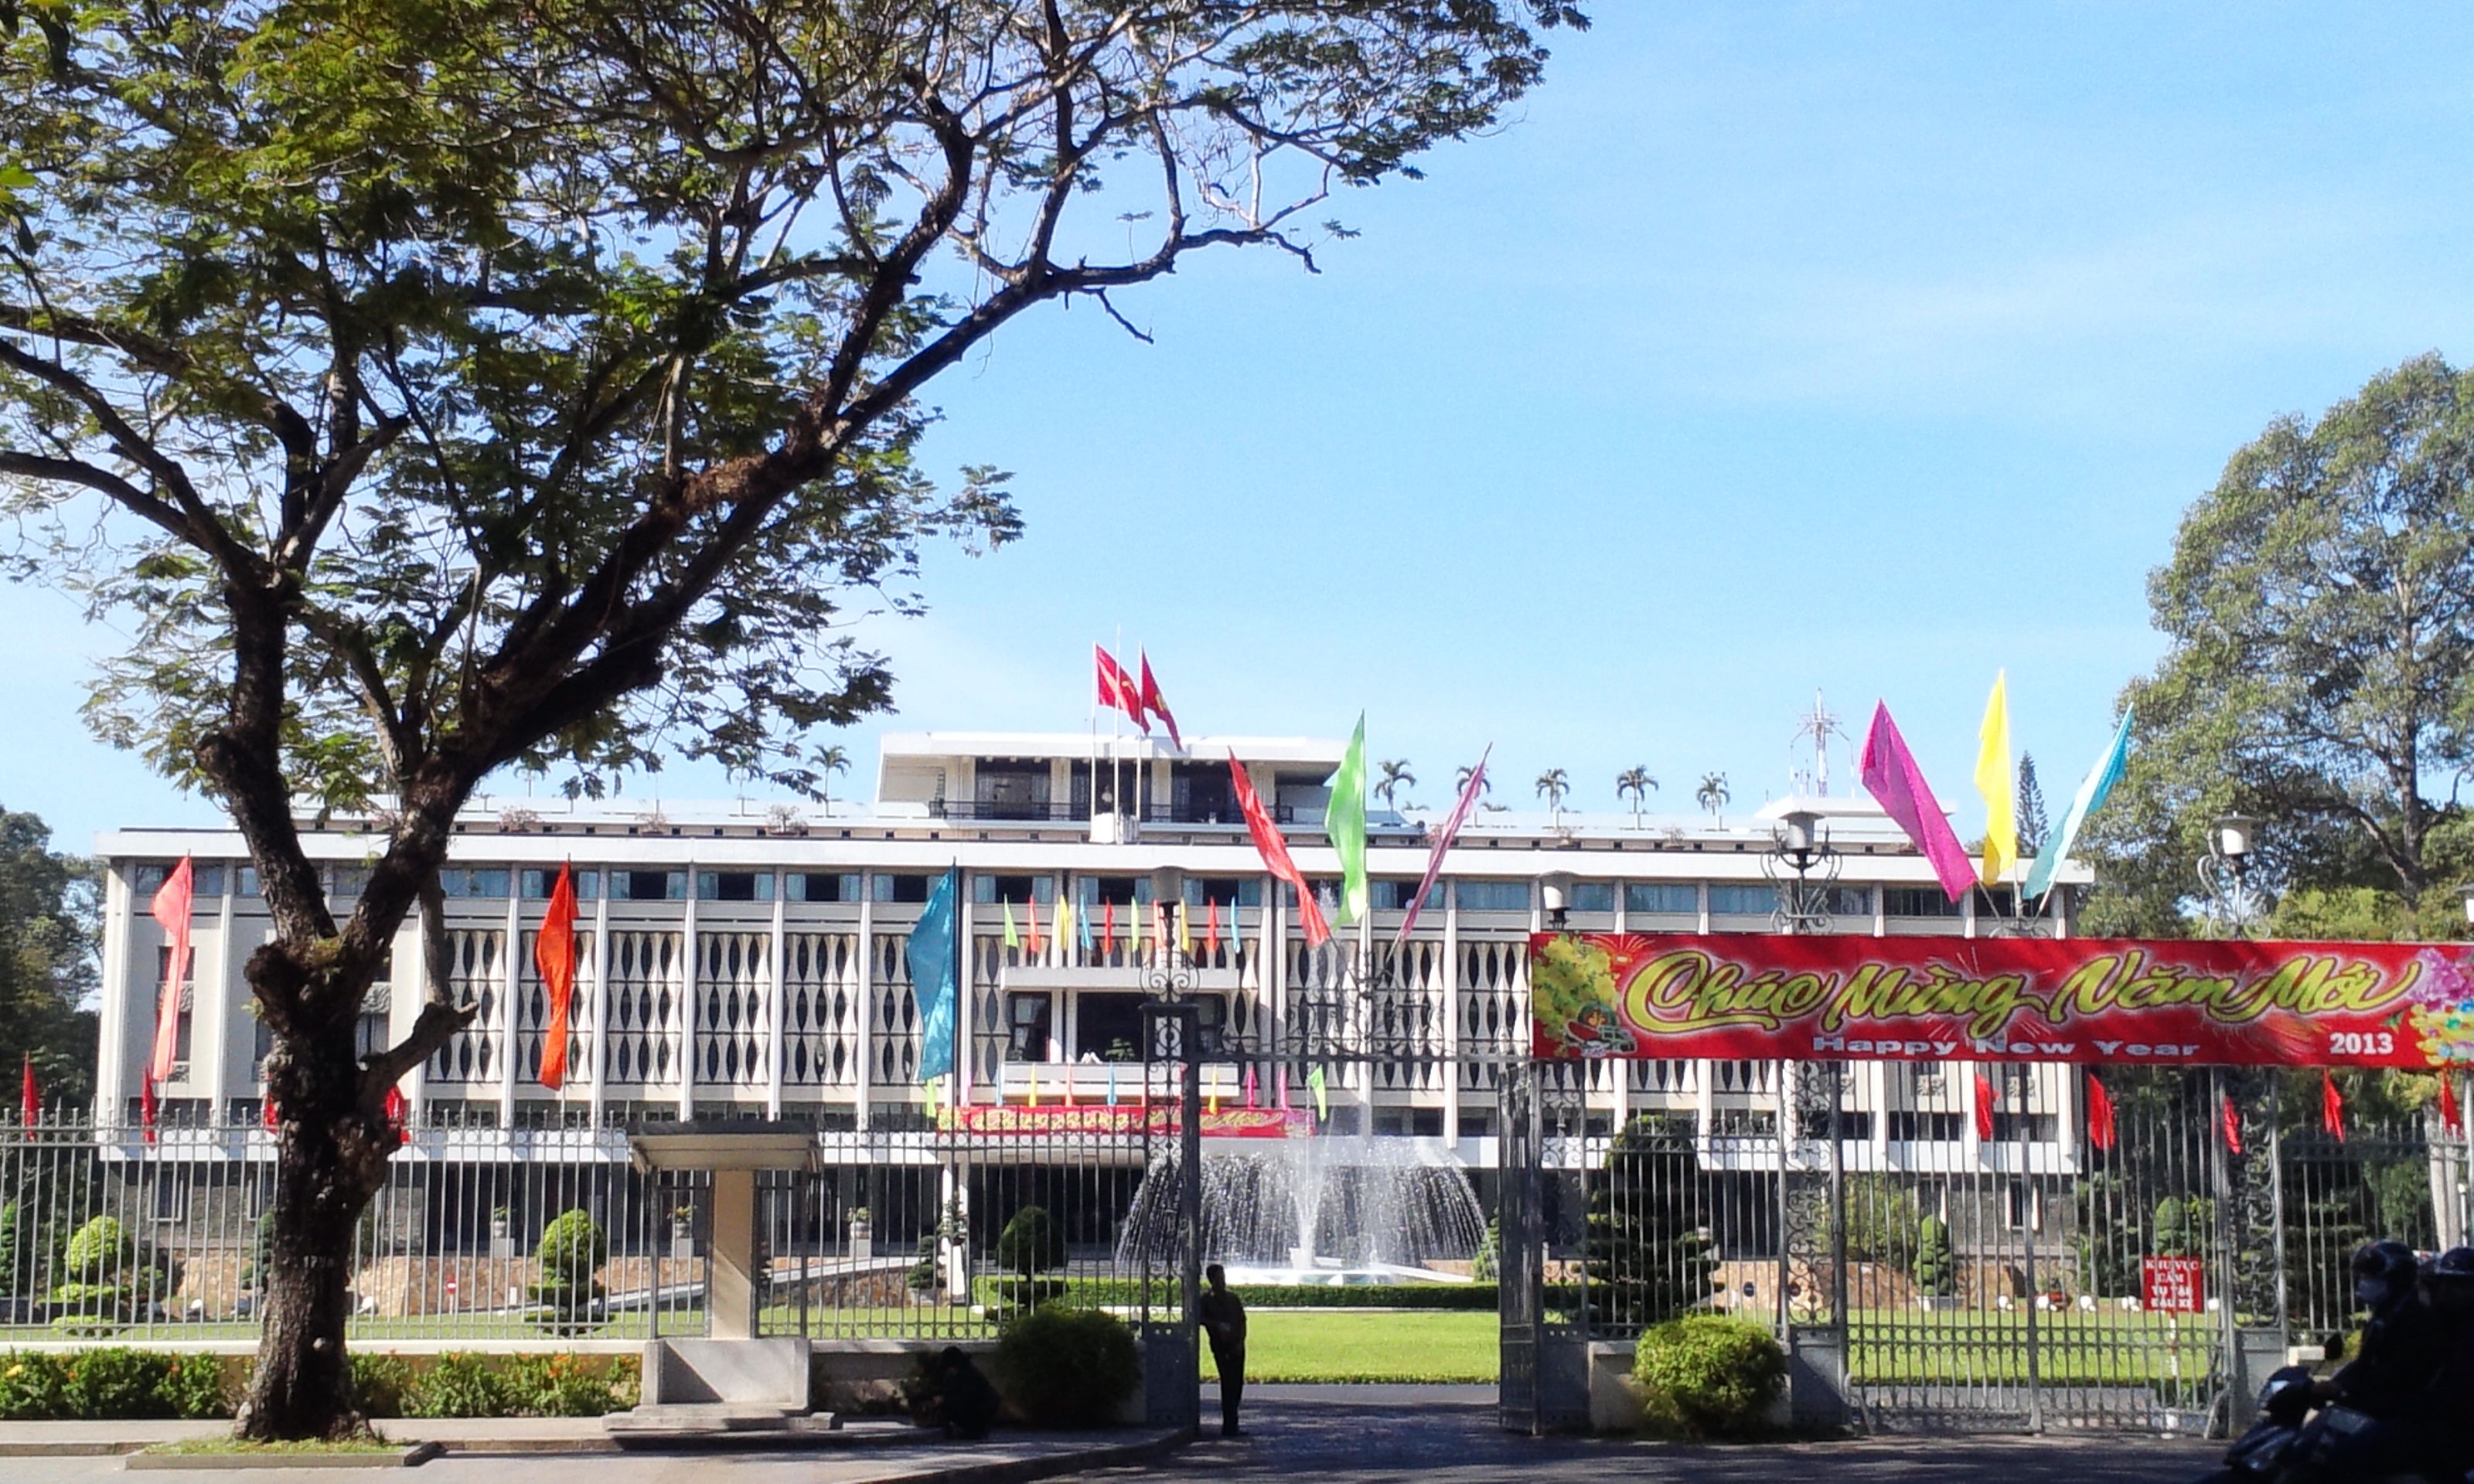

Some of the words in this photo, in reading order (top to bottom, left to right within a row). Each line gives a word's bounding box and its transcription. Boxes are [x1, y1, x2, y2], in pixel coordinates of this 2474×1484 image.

[1624, 950, 1838, 1034] Chúc
[1821, 963, 2047, 1040] Mừng
[2045, 950, 2268, 1023] Năm
[2206, 956, 2423, 1023] Mới
[1813, 1036, 1957, 1056] Happy
[1975, 1036, 2076, 1054] New
[2092, 1040, 2200, 1057] Year
[2329, 1032, 2394, 1055] 2013
